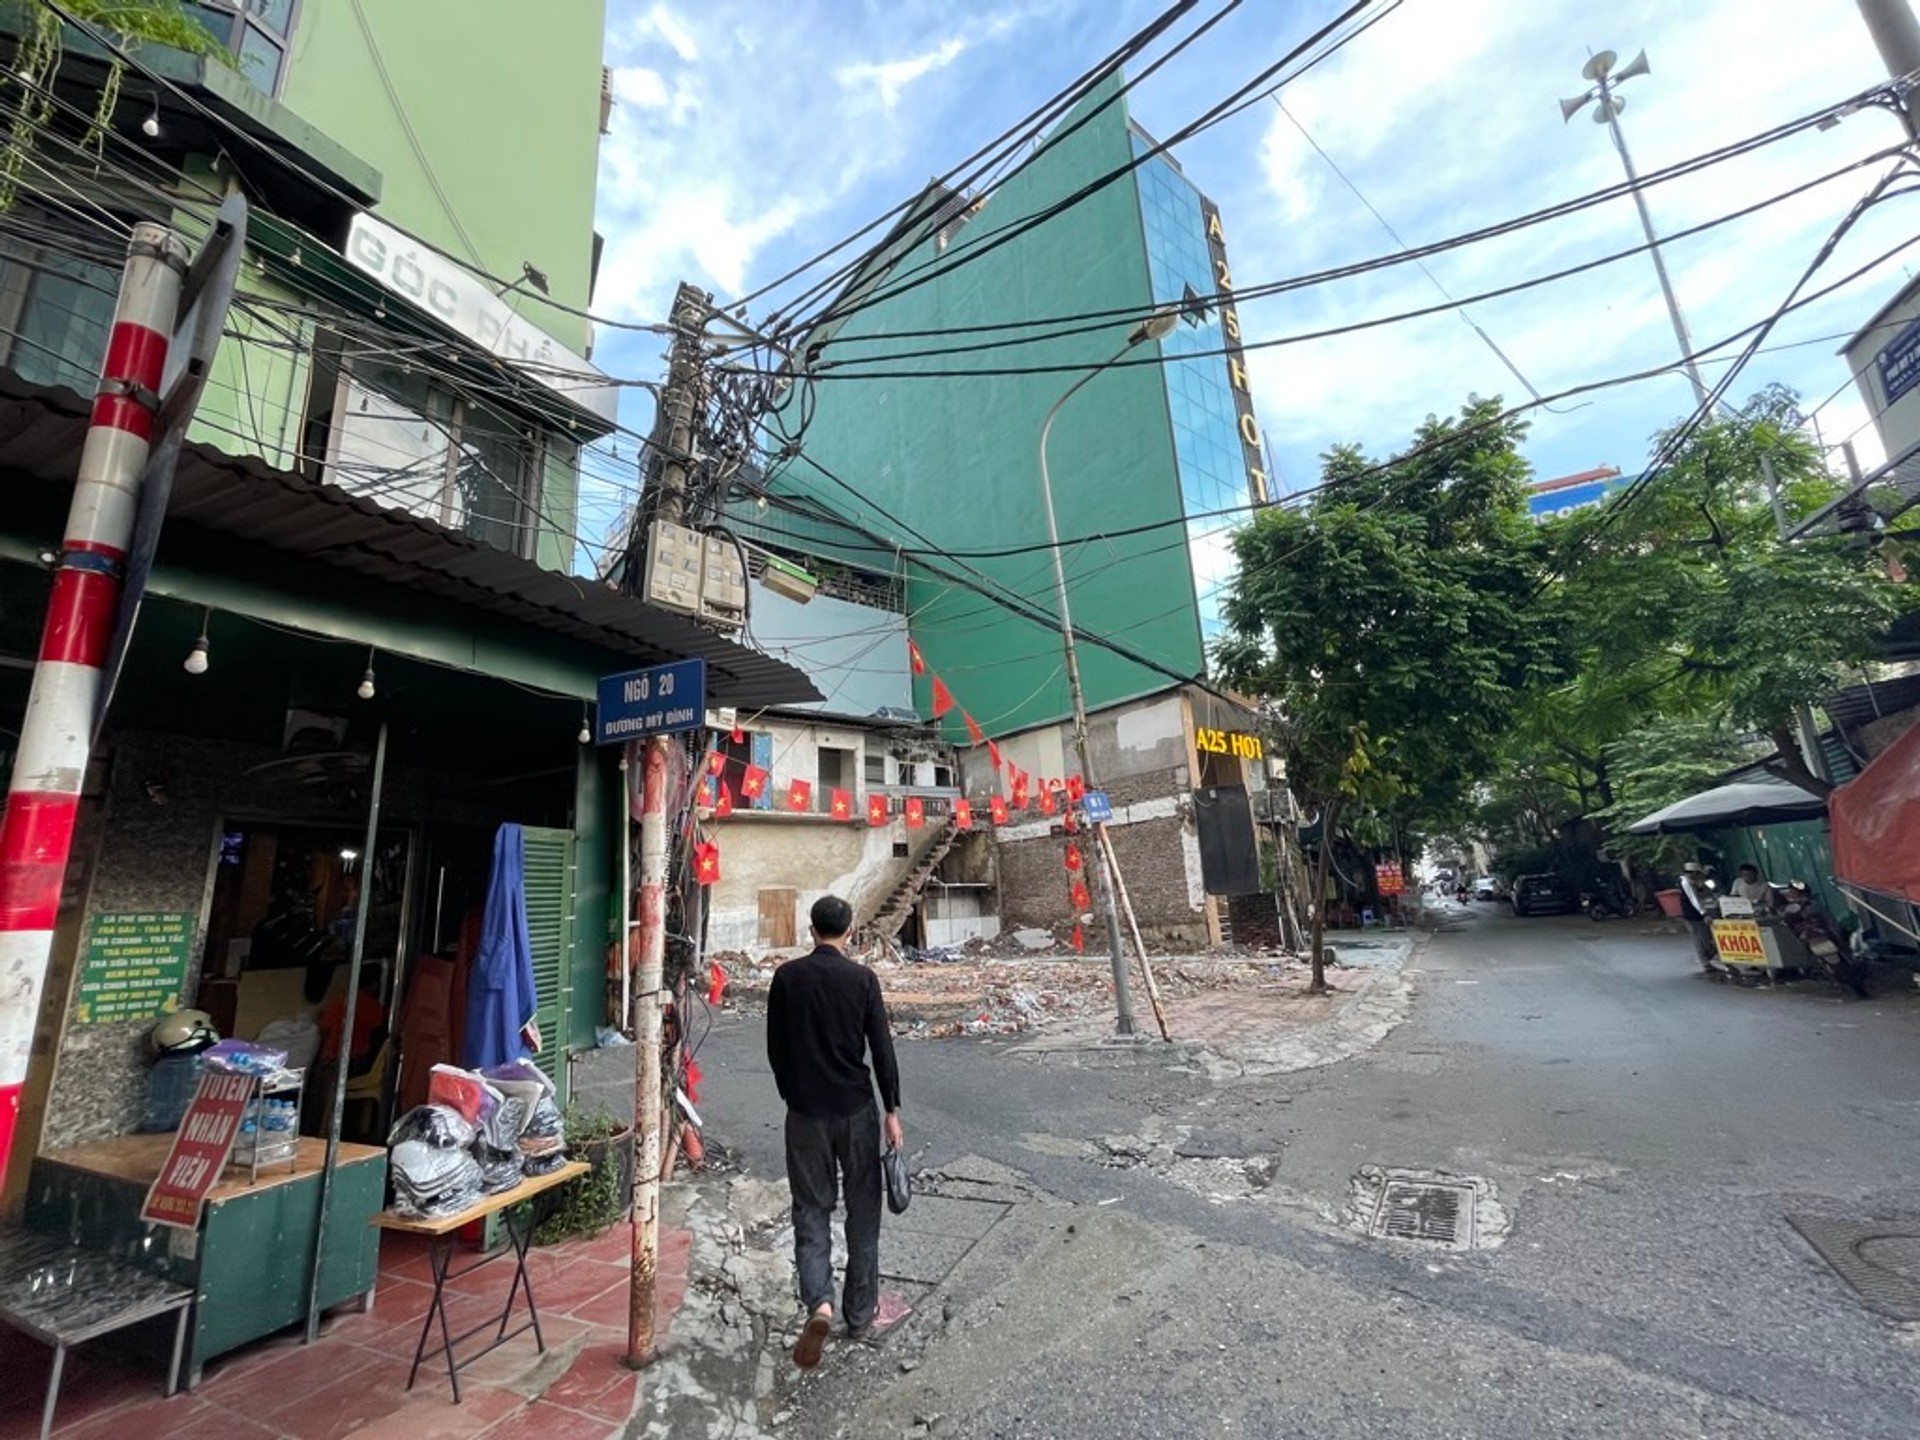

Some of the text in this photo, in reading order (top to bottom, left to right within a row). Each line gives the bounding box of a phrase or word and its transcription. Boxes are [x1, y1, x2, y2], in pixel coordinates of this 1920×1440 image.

[658, 672, 675, 697] 20
[1196, 727, 1228, 754] A25
[1717, 931, 1764, 955] KHÓA
[184, 1108, 234, 1146] NHÂN
[168, 1151, 211, 1191] VIÊN
